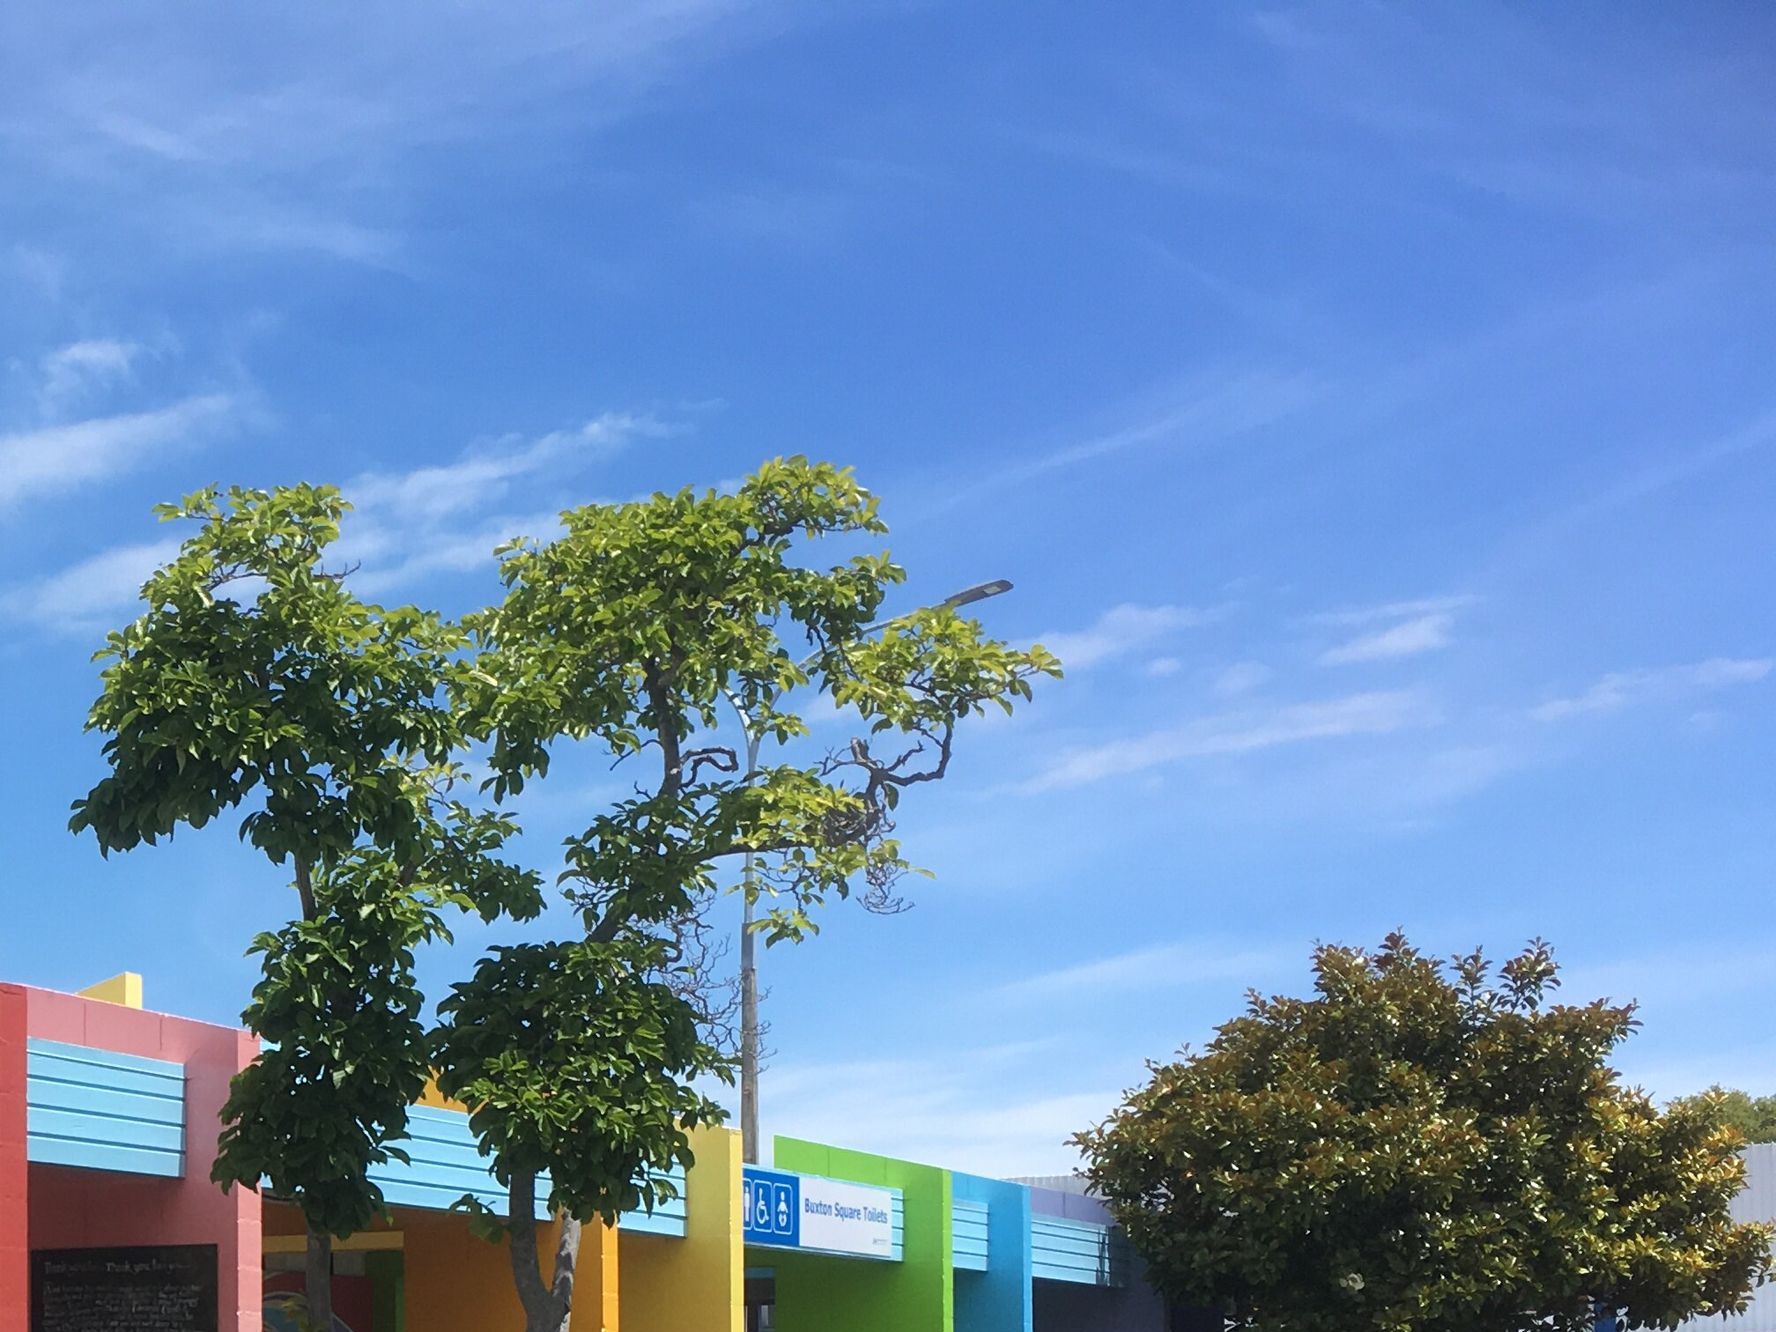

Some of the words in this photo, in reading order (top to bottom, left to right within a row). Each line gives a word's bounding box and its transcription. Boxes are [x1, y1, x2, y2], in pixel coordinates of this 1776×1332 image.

[804, 1198, 833, 1216] Buxton
[834, 1202, 862, 1222] Square
[863, 1206, 888, 1224] Toilets
